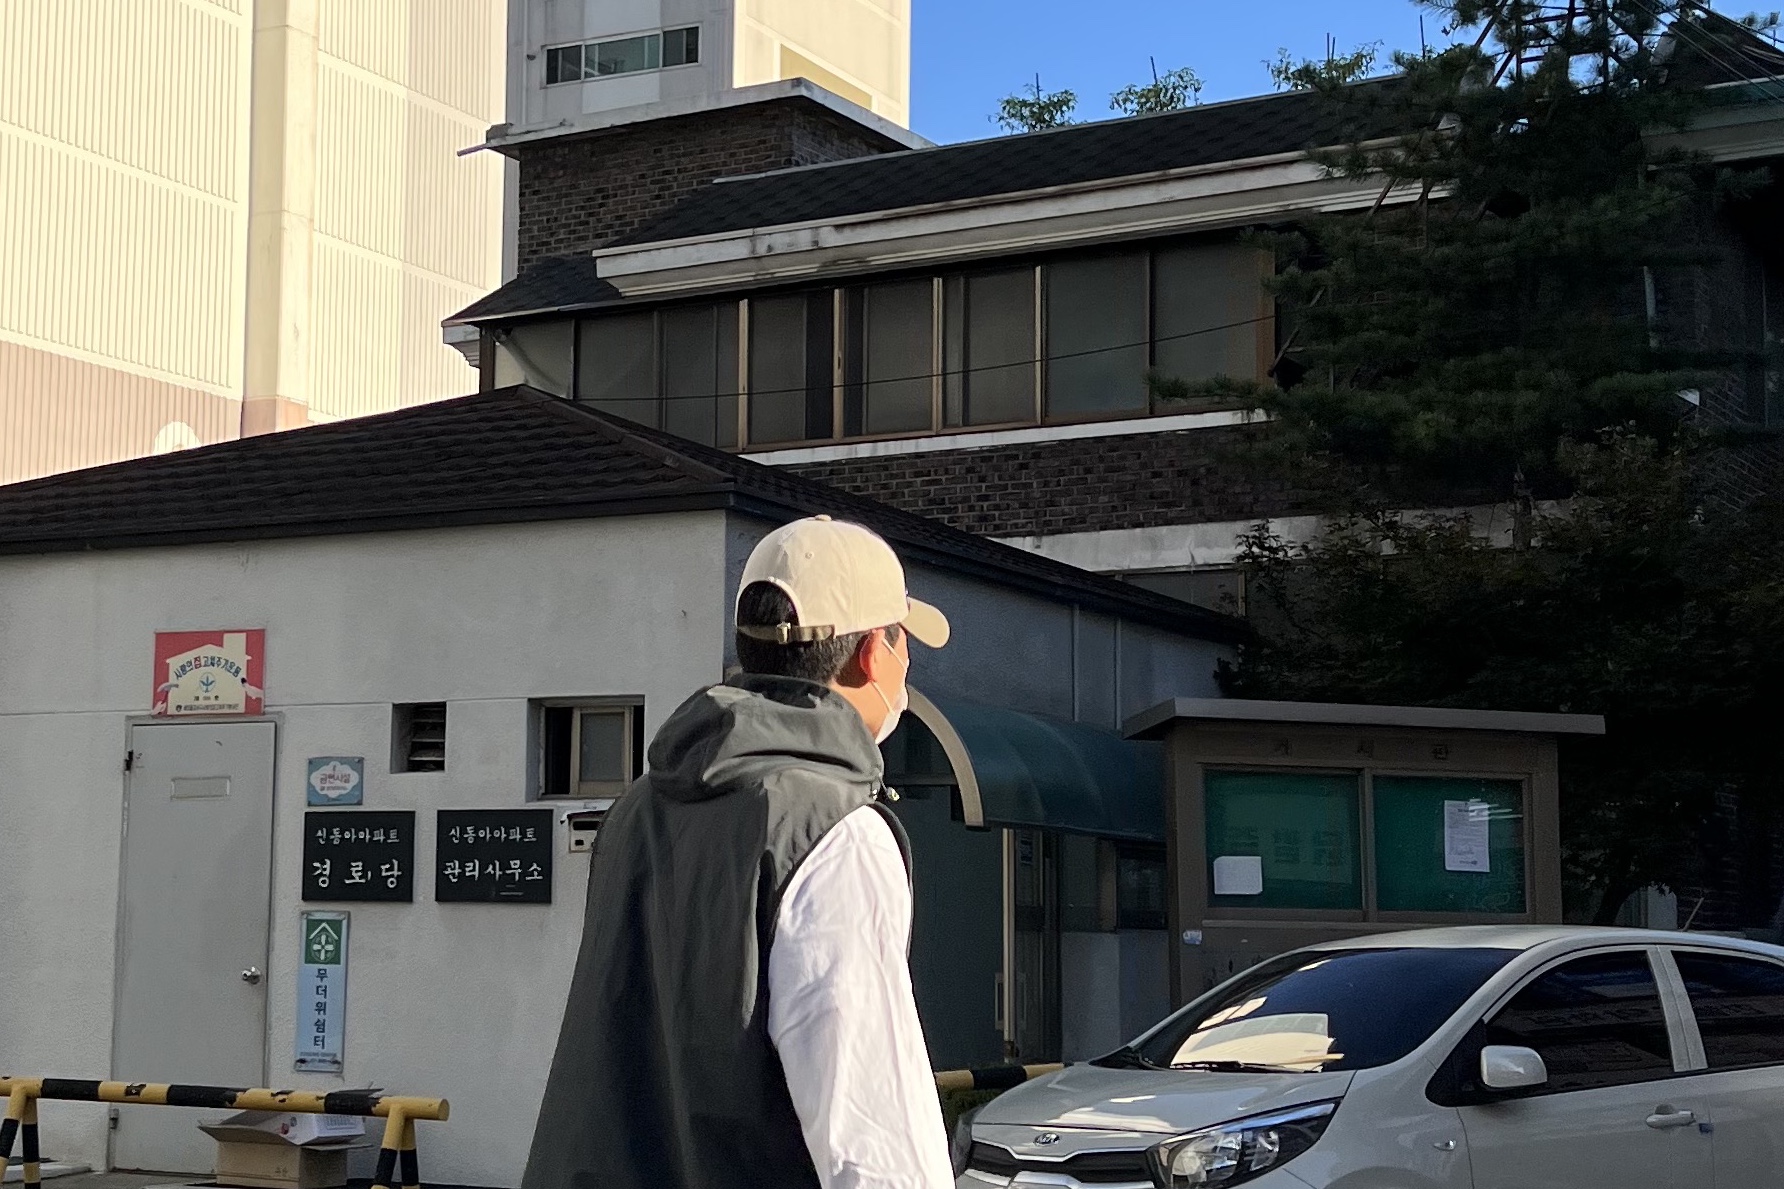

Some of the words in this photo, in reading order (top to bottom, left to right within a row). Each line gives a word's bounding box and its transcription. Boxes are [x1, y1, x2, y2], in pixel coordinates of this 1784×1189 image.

[315, 827, 400, 845] 신동아아파트
[448, 825, 537, 844] 신동아아파트
[442, 859, 544, 883] 관리사무소
[313, 968, 329, 1050] 무더위쉼터
